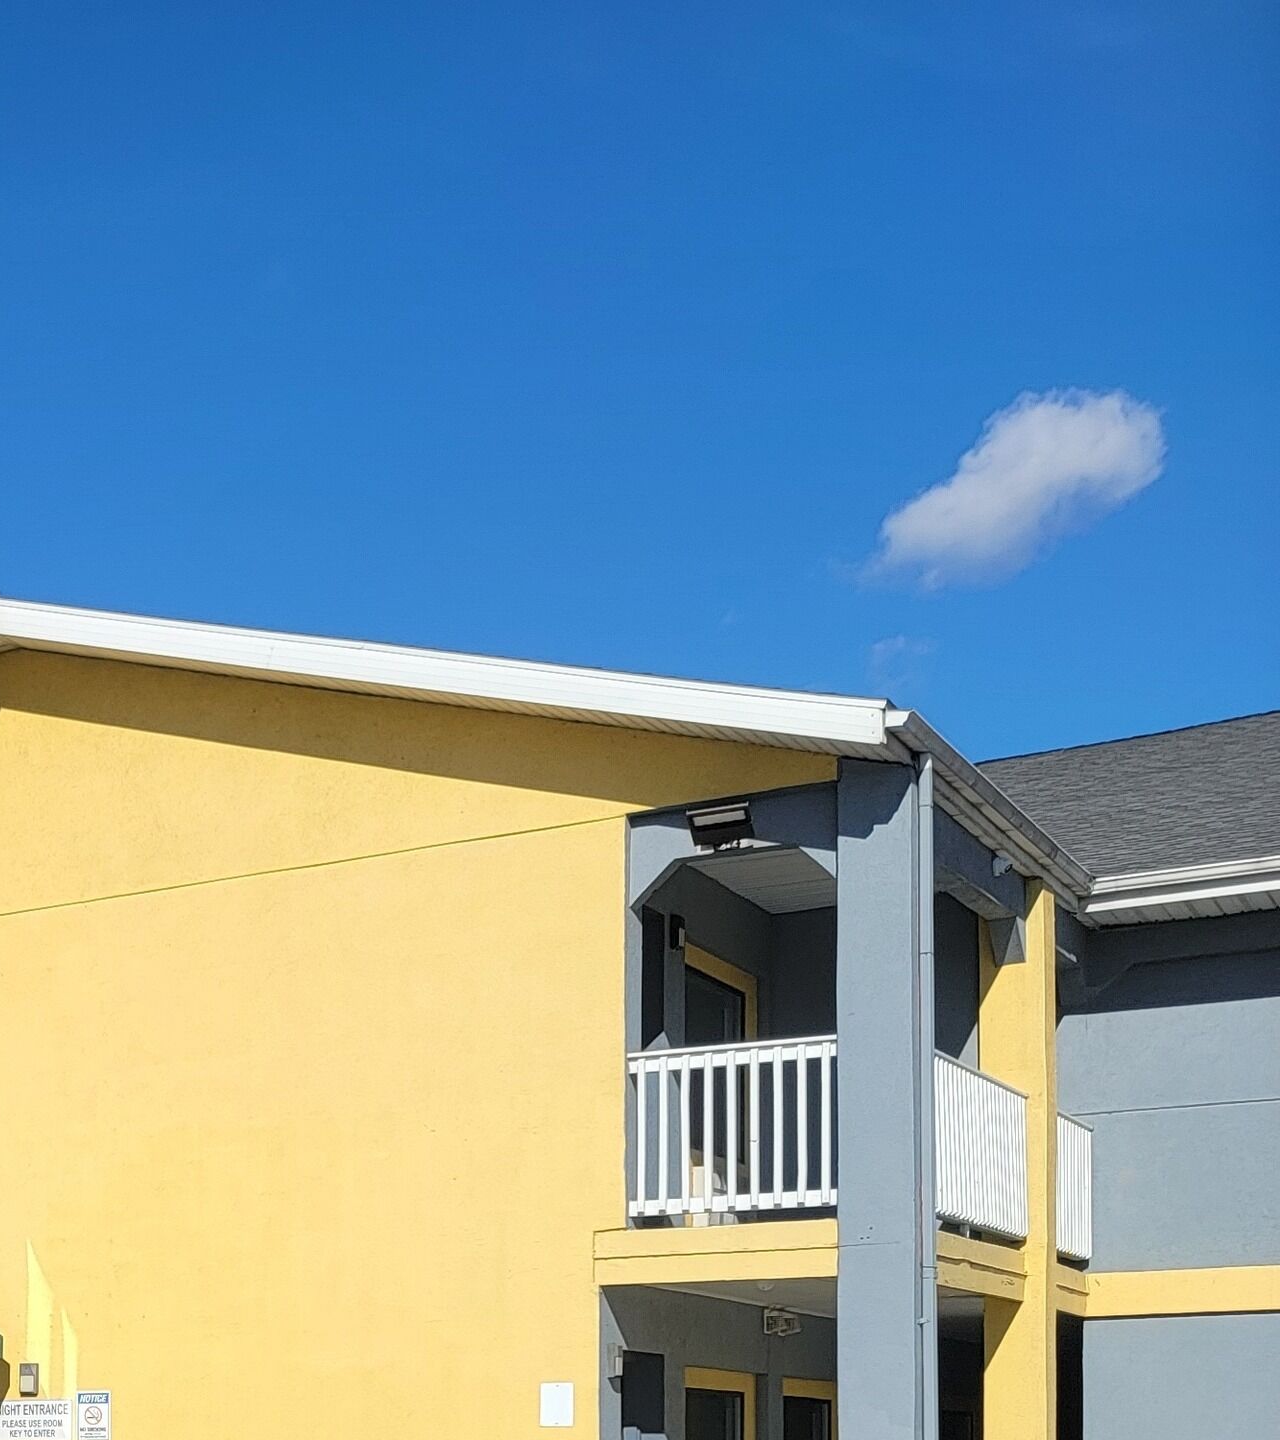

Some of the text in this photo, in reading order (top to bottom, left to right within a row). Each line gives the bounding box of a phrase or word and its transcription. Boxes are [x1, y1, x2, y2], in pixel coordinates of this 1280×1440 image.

[80, 1394, 107, 1403] NOTICE
[23, 1403, 69, 1416] ENTRANCE
[2, 1419, 63, 1428] PLEASE USE ROOM
[9, 1429, 56, 1438] KEY TO ENTER
